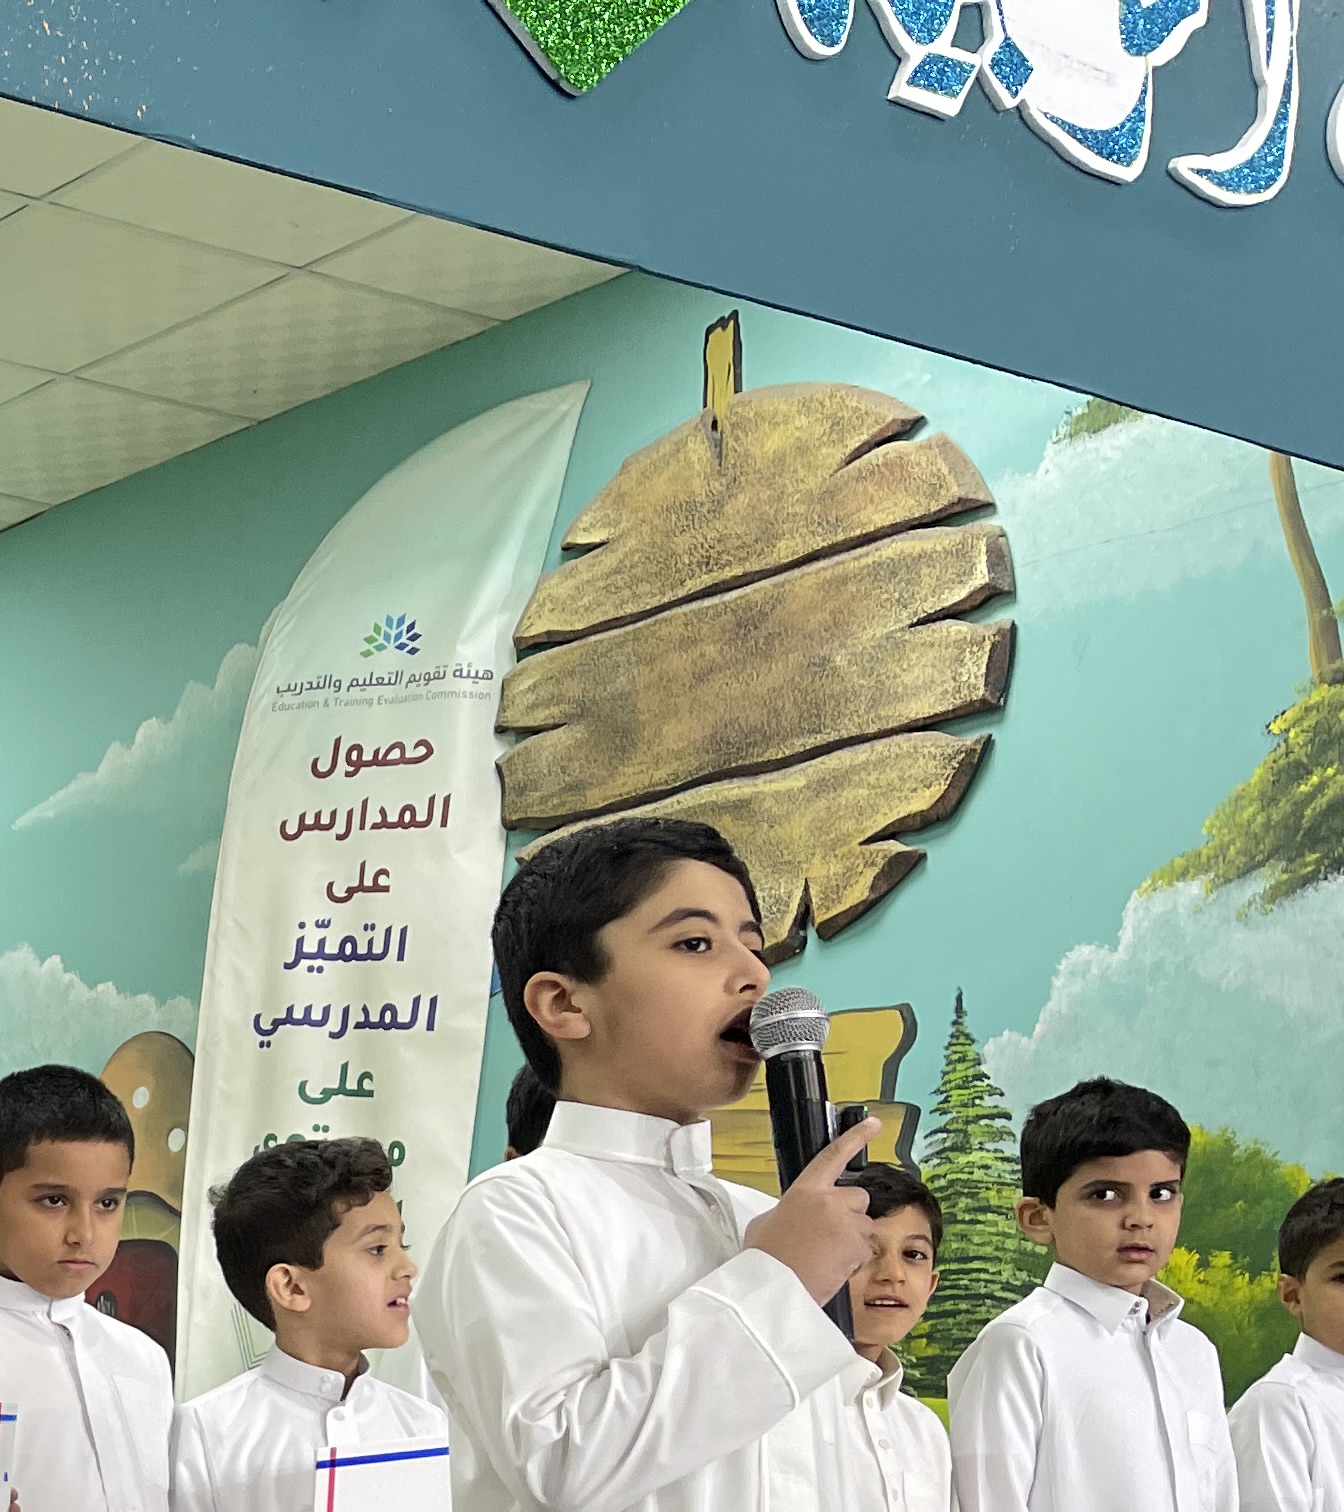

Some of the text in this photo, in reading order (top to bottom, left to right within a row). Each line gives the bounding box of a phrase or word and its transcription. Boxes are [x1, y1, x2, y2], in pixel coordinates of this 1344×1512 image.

[271, 689, 491, 712] Education & Training Evaluation Commission
[276, 663, 493, 696] هيئة تقويم التعليم والتدريب
[311, 735, 435, 779] حصول
[279, 793, 452, 841] المدارس
[326, 860, 391, 904] على
[253, 994, 439, 1049] المدرسي
[298, 1061, 375, 1105] على
